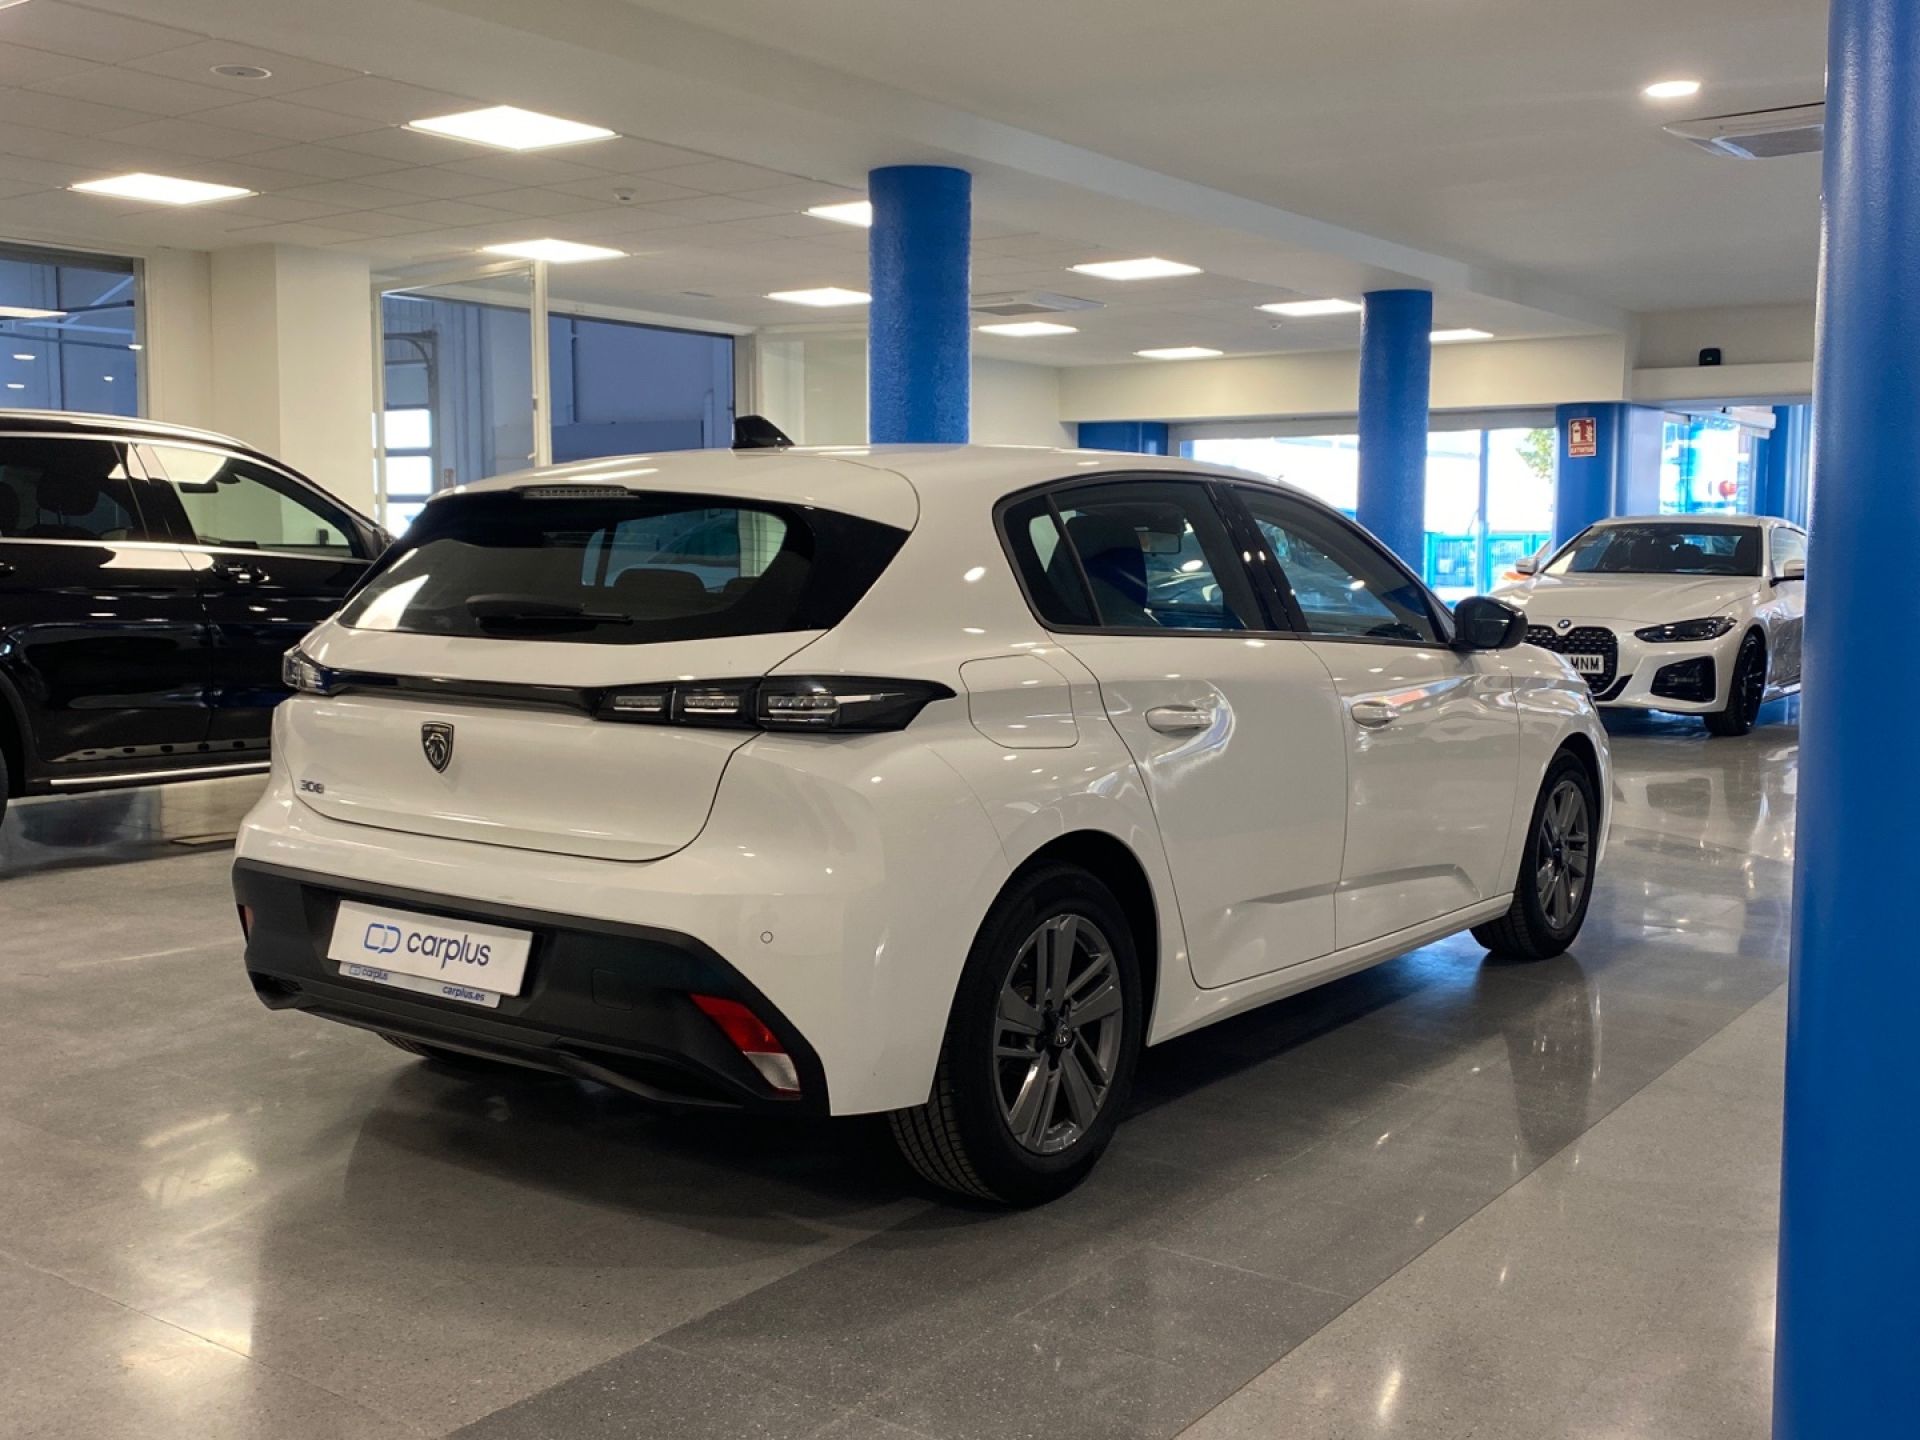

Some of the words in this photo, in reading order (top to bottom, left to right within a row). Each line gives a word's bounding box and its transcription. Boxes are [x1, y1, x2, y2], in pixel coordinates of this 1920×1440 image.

[1570, 656, 1600, 671] MNM
[406, 931, 491, 969] carplus
[442, 985, 485, 1001] carplus.es
